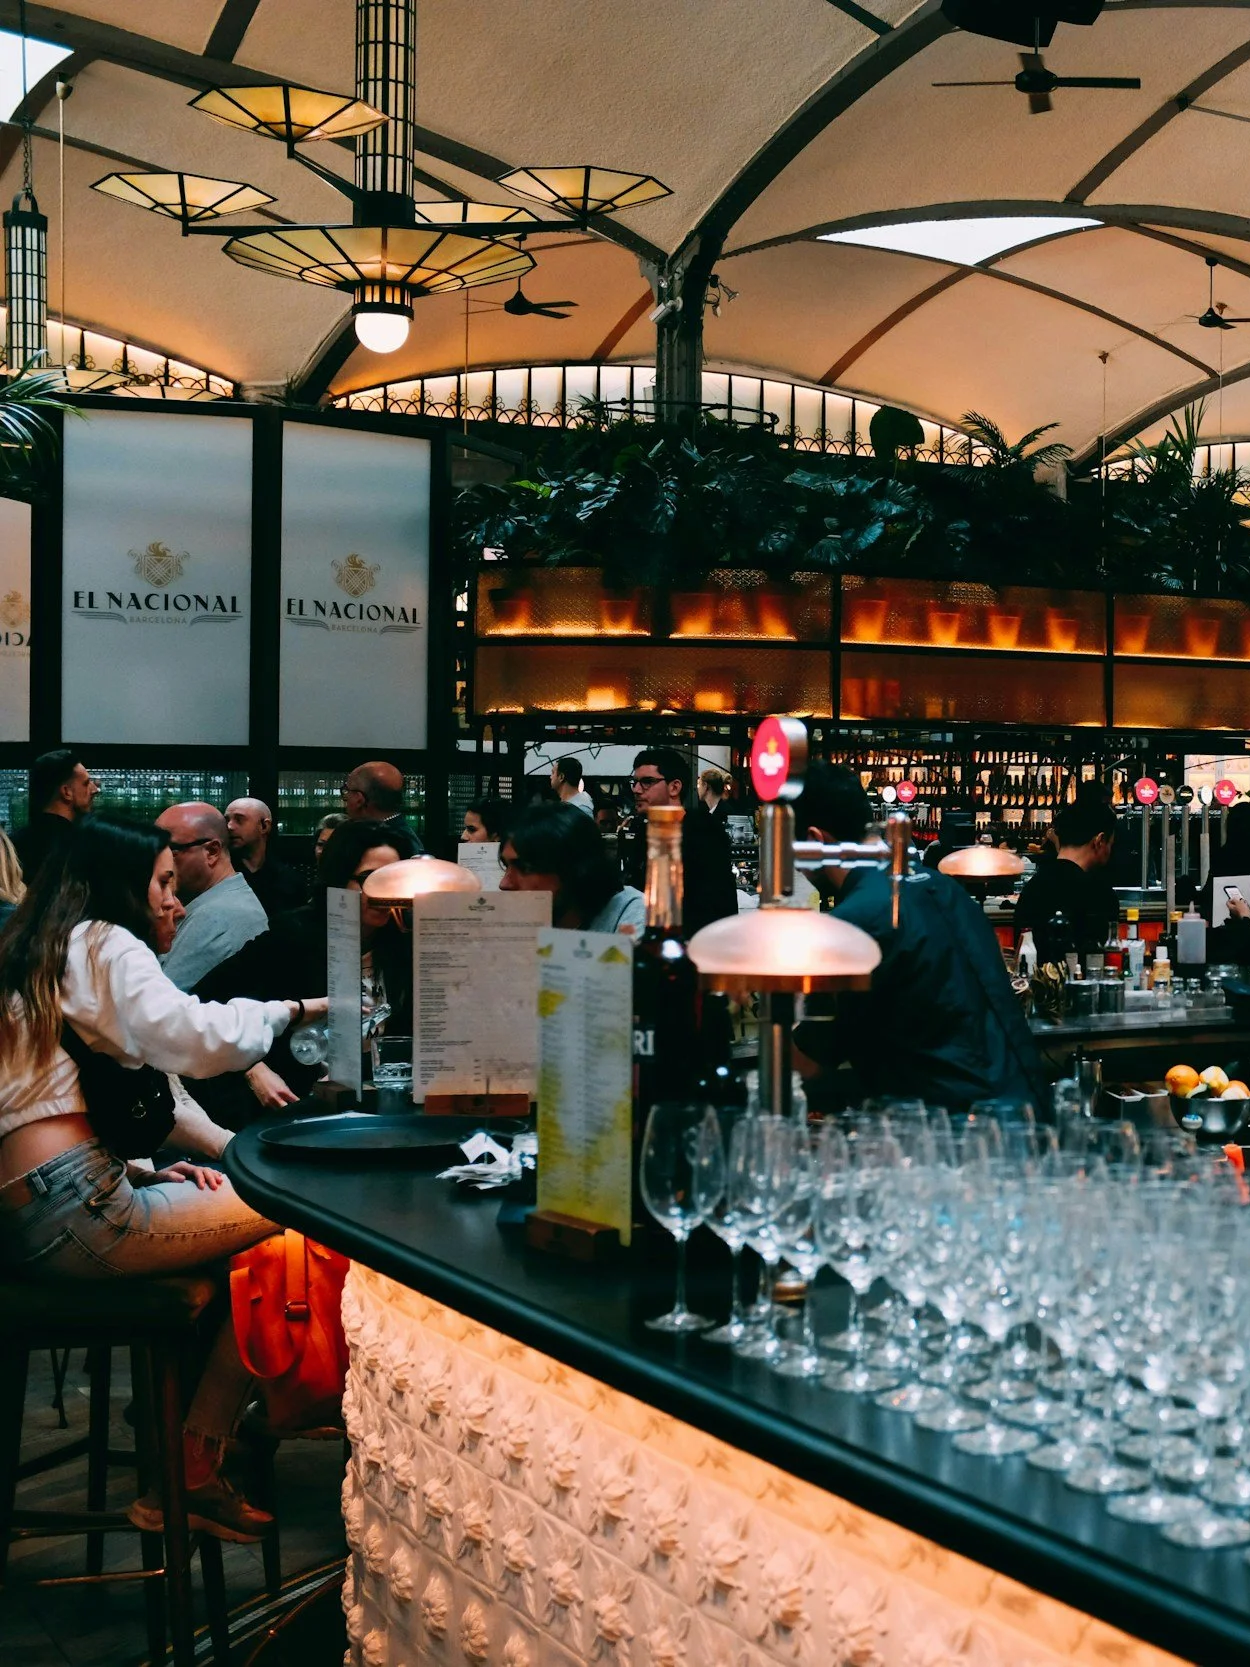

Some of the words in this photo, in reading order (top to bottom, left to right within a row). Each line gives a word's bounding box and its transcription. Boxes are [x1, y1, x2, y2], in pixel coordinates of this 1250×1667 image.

[73, 590, 98, 609] EL
[106, 591, 242, 613] NACIONAL
[286, 598, 308, 616] EL
[313, 600, 421, 625] NACIONAL
[129, 616, 187, 625] BARCELONA
[331, 624, 378, 634] BARCELONA
